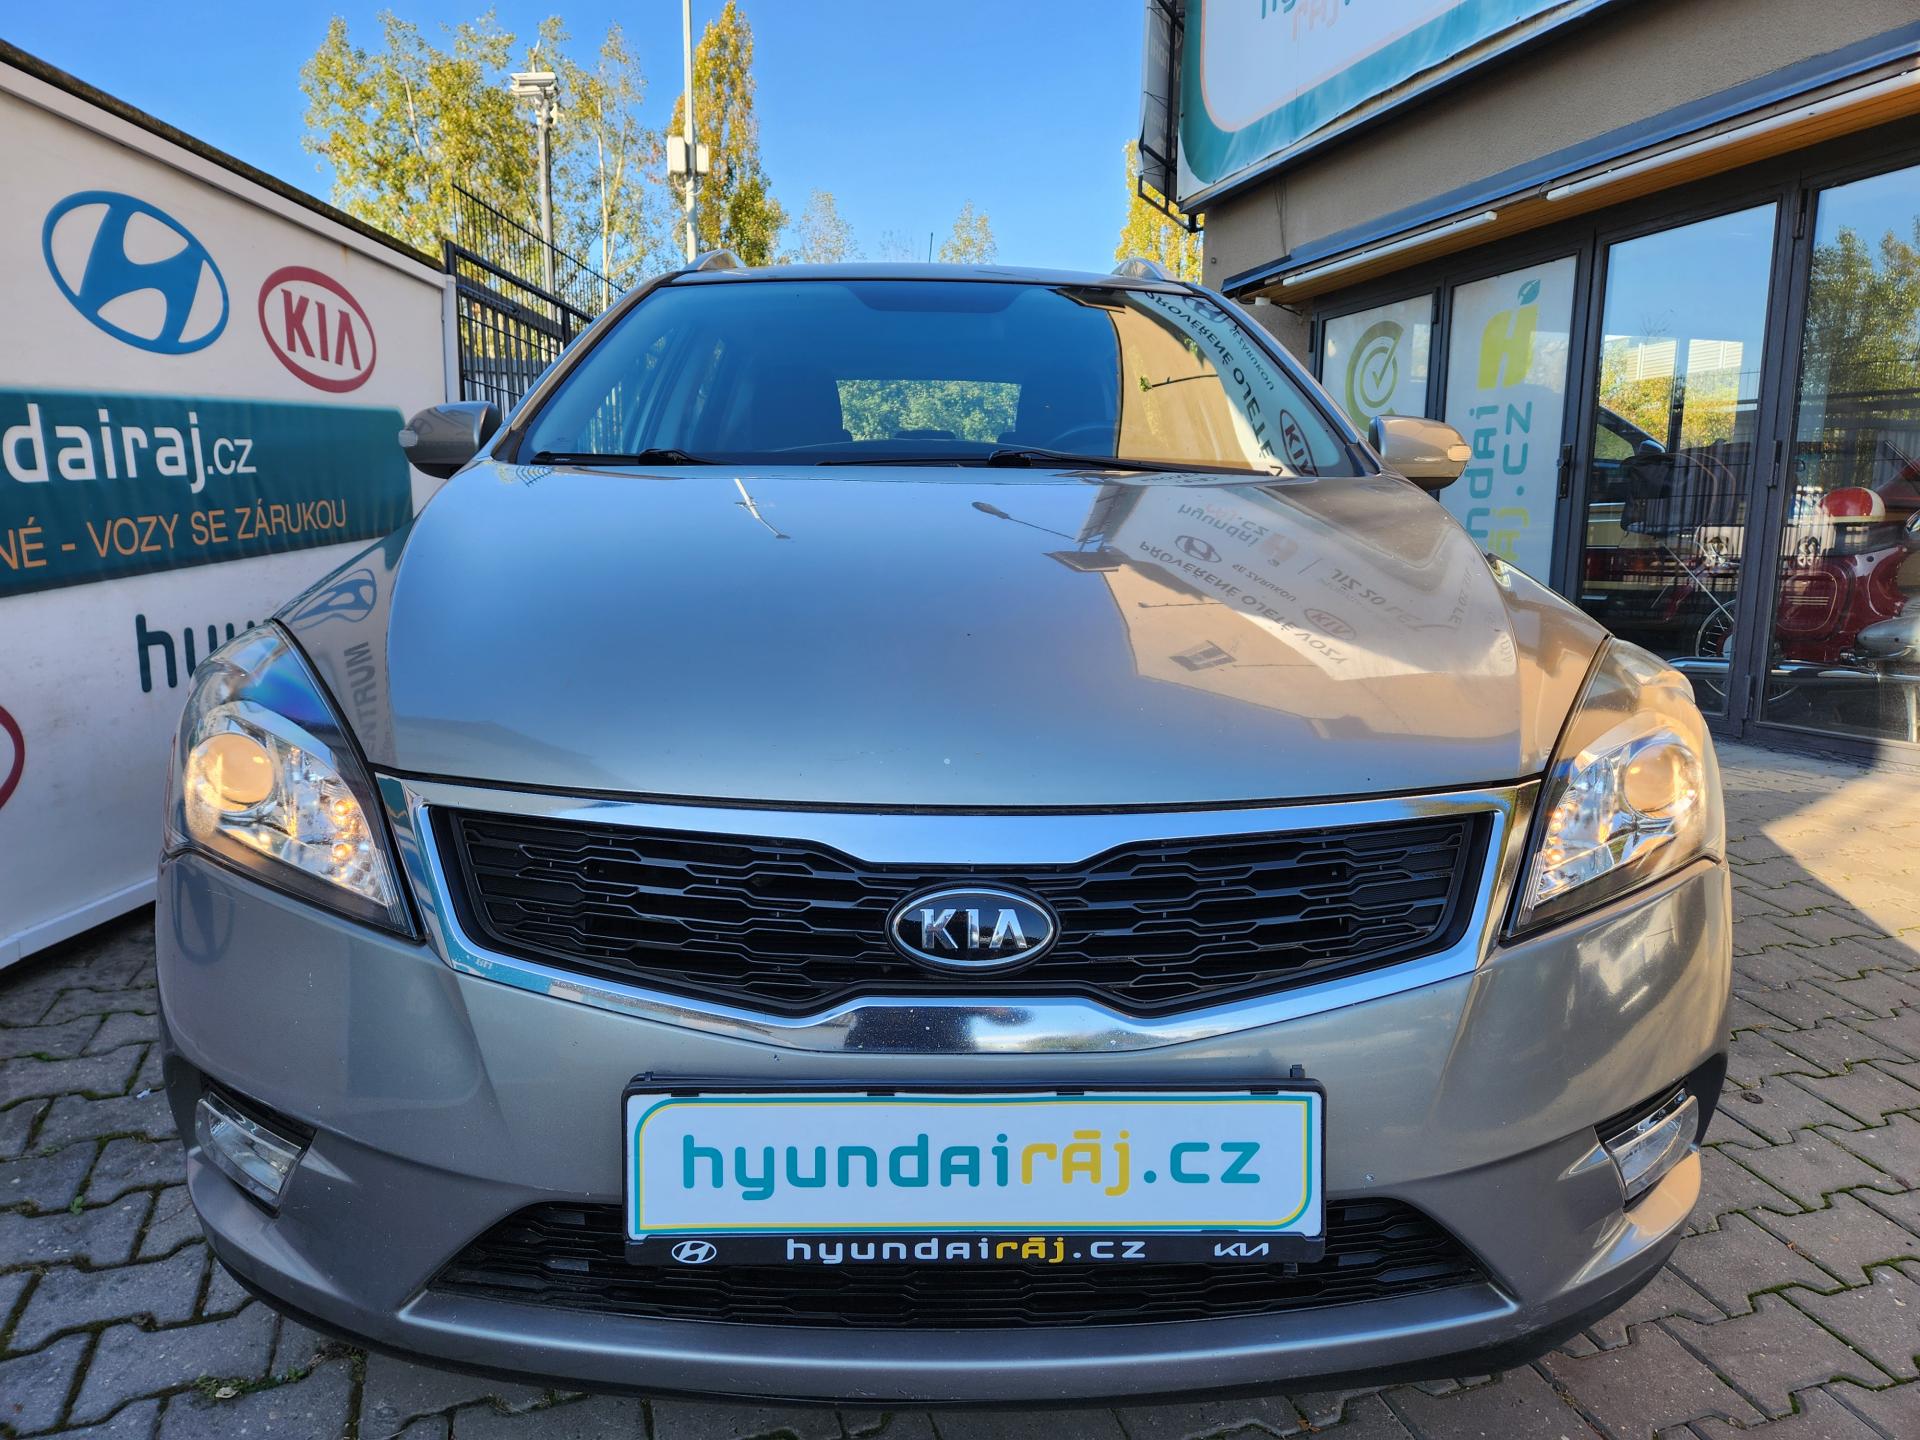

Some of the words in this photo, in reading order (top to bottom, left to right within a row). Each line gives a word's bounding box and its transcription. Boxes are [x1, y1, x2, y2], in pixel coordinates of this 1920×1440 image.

[280, 288, 362, 371] KIA
[2, 403, 257, 494] dairaj.cz
[86, 514, 179, 558] VOZY
[191, 510, 229, 546] SE
[234, 498, 347, 540] ZÁRUKOU
[920, 908, 1029, 949] KIA
